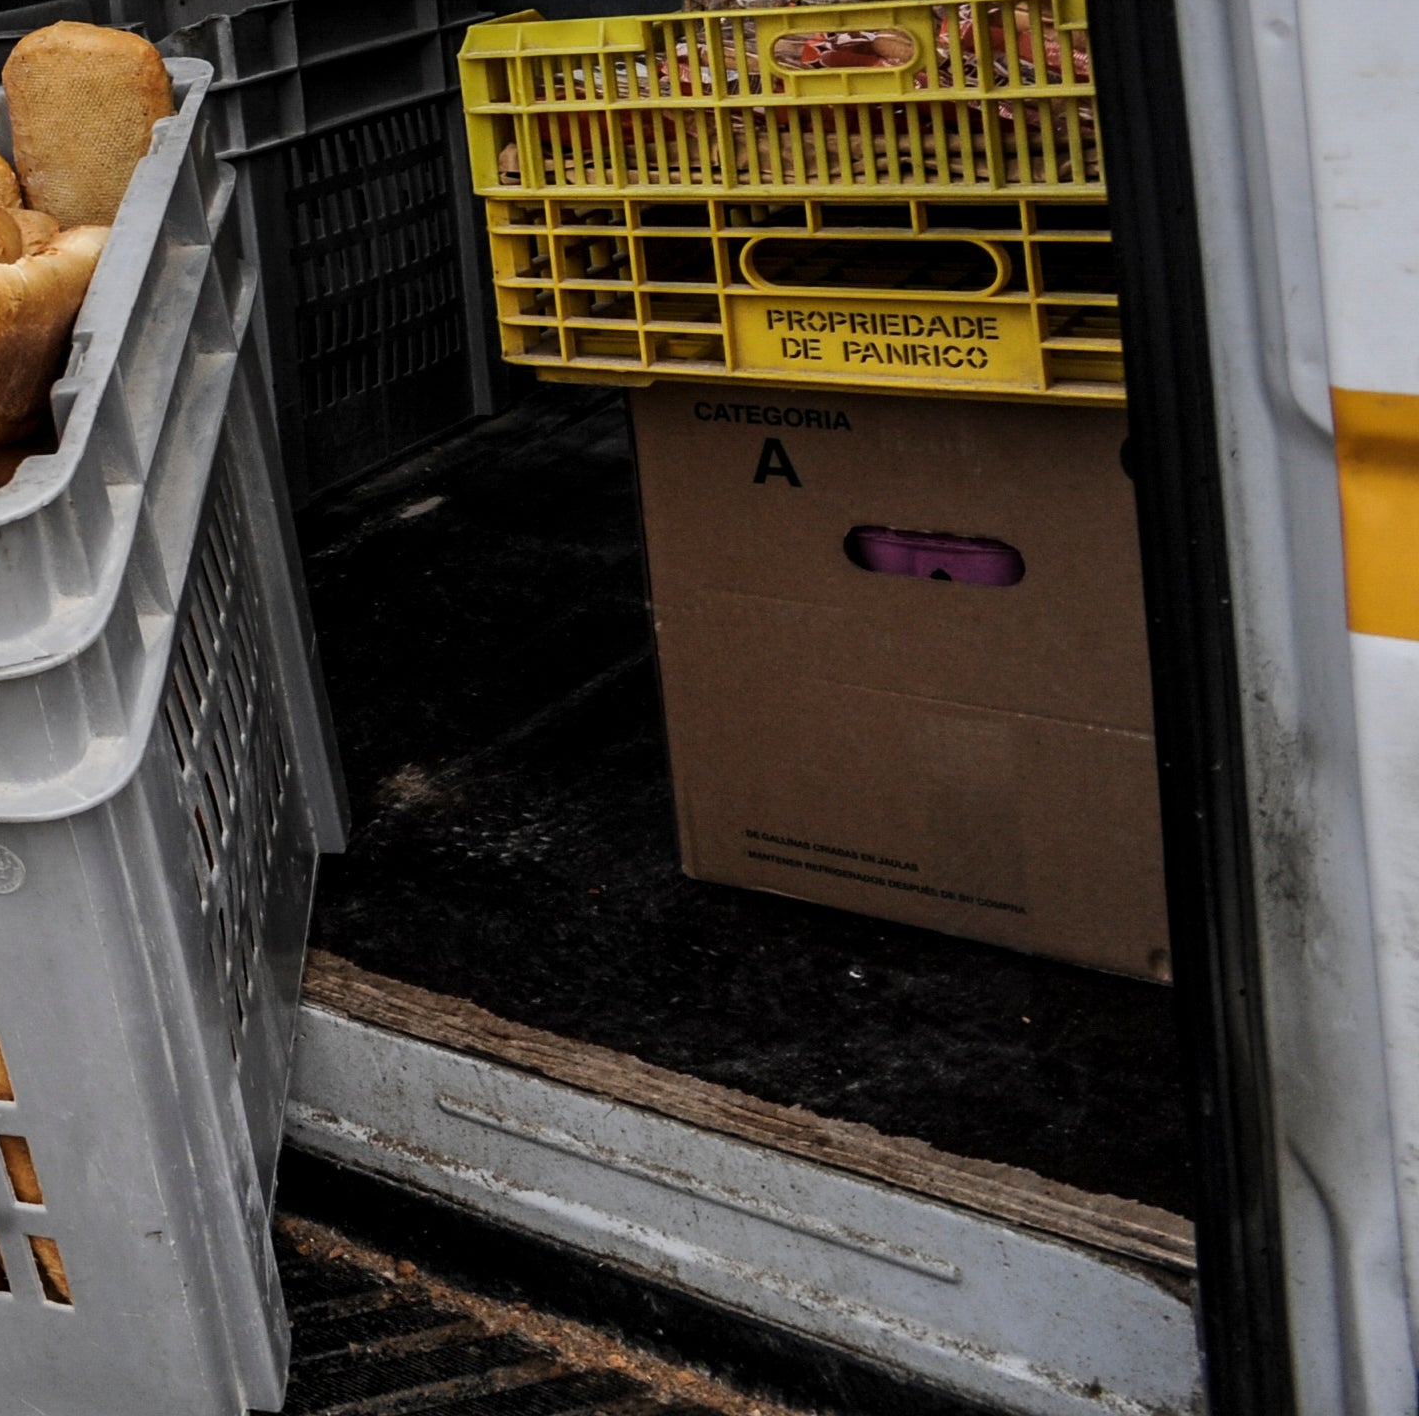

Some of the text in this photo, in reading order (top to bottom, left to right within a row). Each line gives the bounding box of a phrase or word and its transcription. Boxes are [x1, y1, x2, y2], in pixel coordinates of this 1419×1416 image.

[766, 308, 999, 341] PROPRIEDADE
[781, 337, 989, 371] DE PANRICO
[693, 401, 852, 432] CATEGORIA
[753, 437, 802, 488] A
[746, 829, 760, 840] DE
[761, 832, 811, 850] GALLINAS
[813, 844, 859, 860] CRIADAS
[878, 856, 920, 872] JAULAS
[747, 850, 803, 868] MANTENER
[804, 861, 886, 887] REFRIGERADOS
[940, 889, 956, 901] DE
